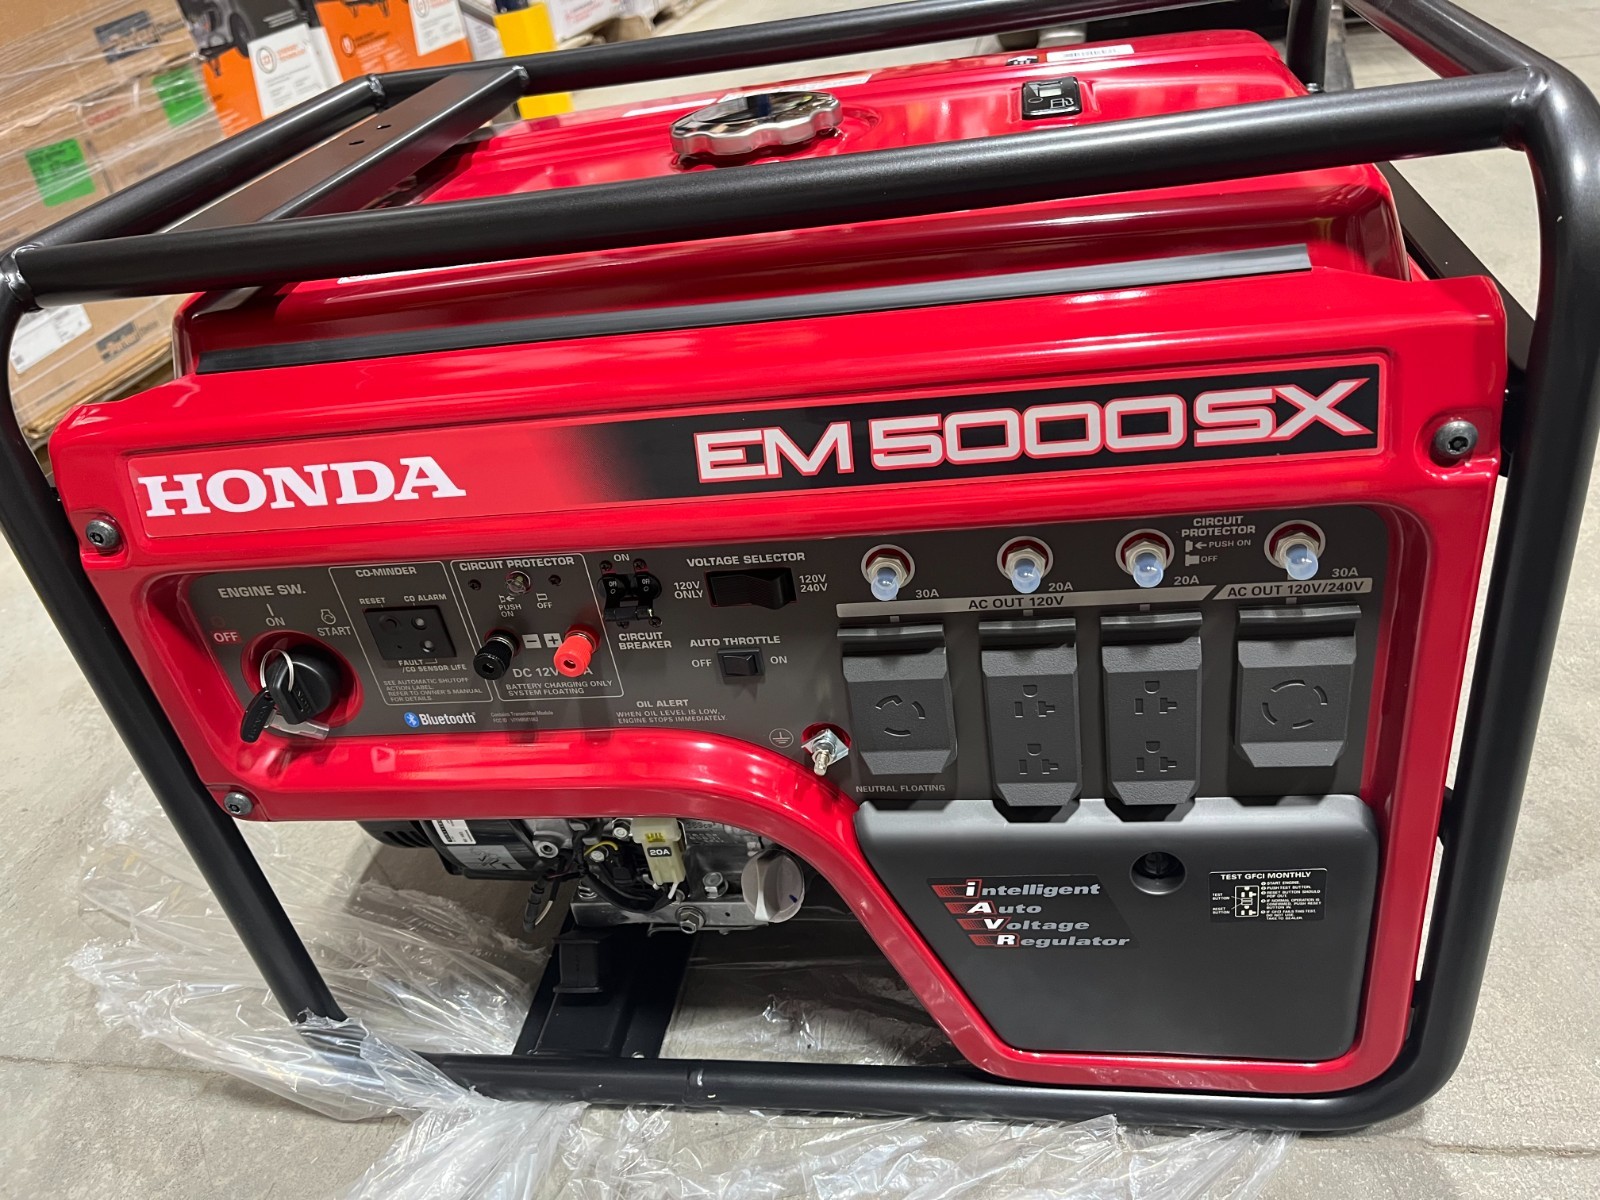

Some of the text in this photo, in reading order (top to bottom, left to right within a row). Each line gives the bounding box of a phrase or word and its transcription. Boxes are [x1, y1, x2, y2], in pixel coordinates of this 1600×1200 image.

[138, 456, 466, 517] HONDA
[1193, 516, 1243, 526] CIRCUIT
[1181, 525, 1256, 538] PROTECTOR
[1208, 539, 1251, 548] PUSH ON
[614, 554, 630, 562] ON
[686, 552, 806, 568] VOLTAGE SELECTOR
[459, 556, 575, 572] CIRCUIT PROTECTOR
[356, 566, 418, 578] CO-MINDER
[1331, 567, 1359, 578] 30A
[798, 574, 826, 584] 120V
[1174, 576, 1200, 586] 20A
[674, 581, 700, 590] 120V
[800, 583, 828, 593] 240V
[1048, 582, 1073, 592] 20A
[1227, 580, 1364, 597] AC OUT 120V/240V
[218, 584, 306, 599] ENGINE SW.
[674, 590, 704, 600] ONLY
[915, 589, 939, 598] 30A
[359, 597, 386, 605] RESET
[418, 594, 447, 602] ALARM
[968, 596, 1064, 610] AC OUT 120V
[498, 603, 522, 611] PUSH
[536, 602, 552, 610] OFF
[265, 616, 286, 627] ON
[316, 626, 351, 638] START
[618, 632, 663, 642] CIRCUIT
[214, 632, 239, 644] OFF
[690, 636, 781, 648] AUTO THROTTLE
[618, 640, 672, 650] BREAKER
[691, 659, 712, 668] OFF
[770, 655, 788, 664] ON
[418, 664, 449, 672] SENSOR
[512, 668, 532, 678] DC
[544, 682, 588, 690] CHARGING
[590, 680, 612, 688] ONLY
[543, 688, 584, 696] FLOATING
[636, 699, 689, 708] OIL ALERT
[616, 710, 641, 718] WHEN
[688, 708, 696, 716] IS
[648, 716, 674, 724] STOPS
[856, 784, 946, 793] NEUTRAL FLOATING
[650, 848, 670, 856] 20A
[967, 902, 1042, 914] Auto
[984, 918, 1090, 932] Voltage
[996, 934, 1130, 948] Regulator
